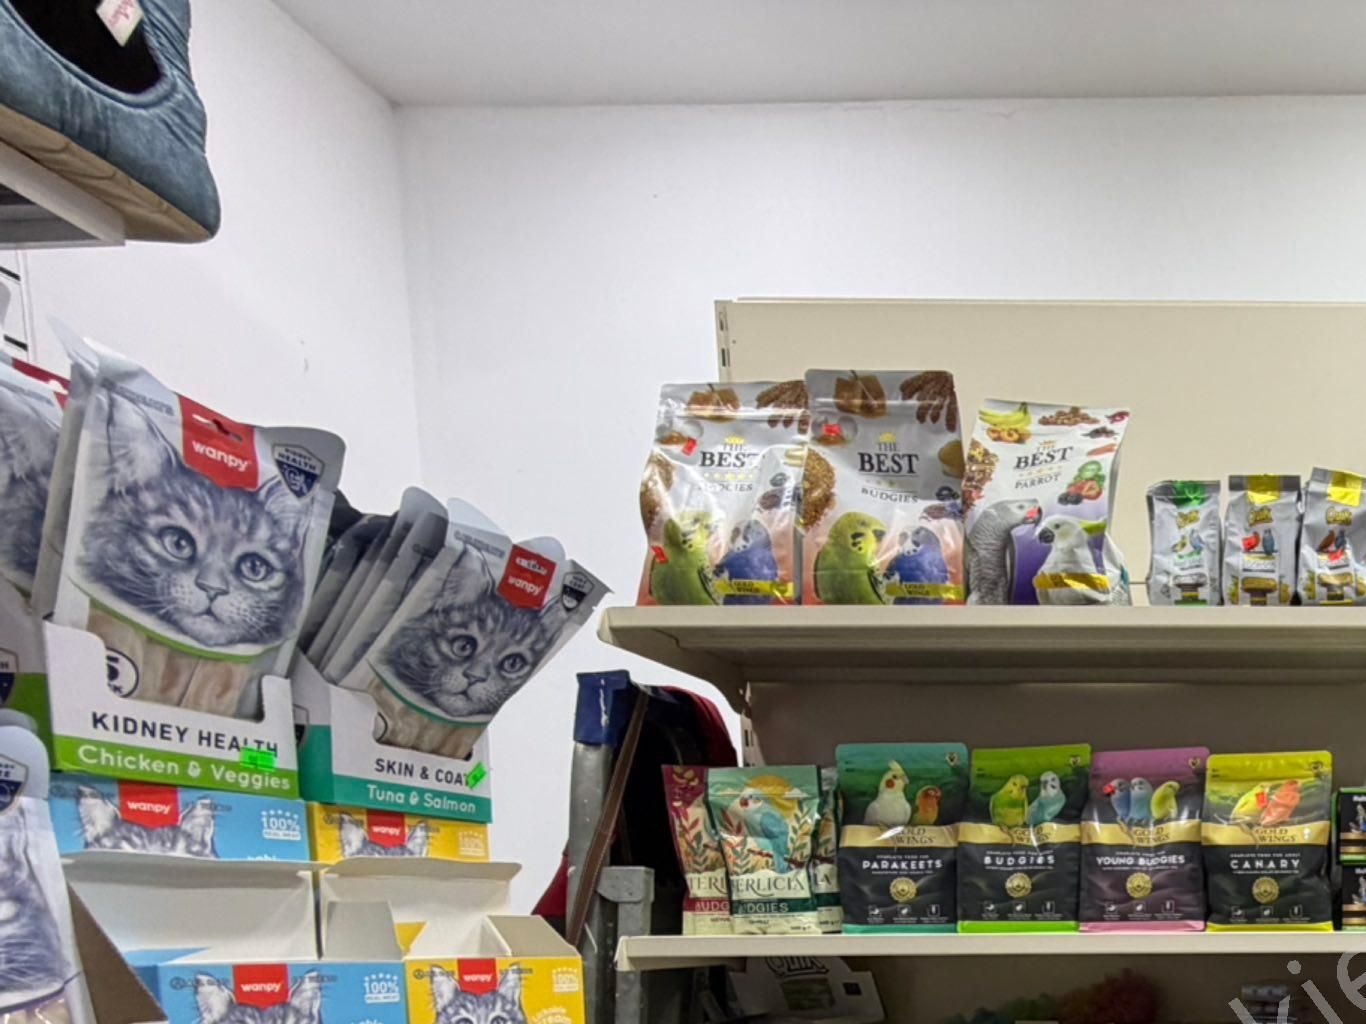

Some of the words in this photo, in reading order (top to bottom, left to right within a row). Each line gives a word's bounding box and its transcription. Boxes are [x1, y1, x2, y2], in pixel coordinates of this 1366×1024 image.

[191, 440, 250, 472] wanpy
[857, 453, 919, 474] BEST
[1014, 446, 1074, 470] BEST
[1014, 472, 1062, 489] PARROT
[860, 487, 919, 503] BUDGIES
[507, 574, 543, 595] wanpy
[91, 711, 189, 743] KIDNEY
[78, 745, 180, 775] Chicken
[187, 762, 202, 778] &
[211, 764, 291, 790] Veggies
[375, 758, 415, 777] SKIN
[420, 766, 430, 780] &
[367, 784, 405, 804] Tuna
[424, 794, 476, 813] Salmon
[127, 801, 171, 815] wanpy
[261, 817, 300, 831] 100%
[1255, 828, 1289, 836] GOLD
[1258, 834, 1297, 842] WINGS
[862, 859, 943, 870] PARAKEETS
[983, 856, 1055, 865] BUDGIES
[1096, 856, 1135, 866] YOUNG
[1137, 855, 1185, 866] BUDGIES
[1229, 859, 1300, 870] CANARY
[241, 981, 283, 992] wanpy
[364, 982, 399, 995] 100%
